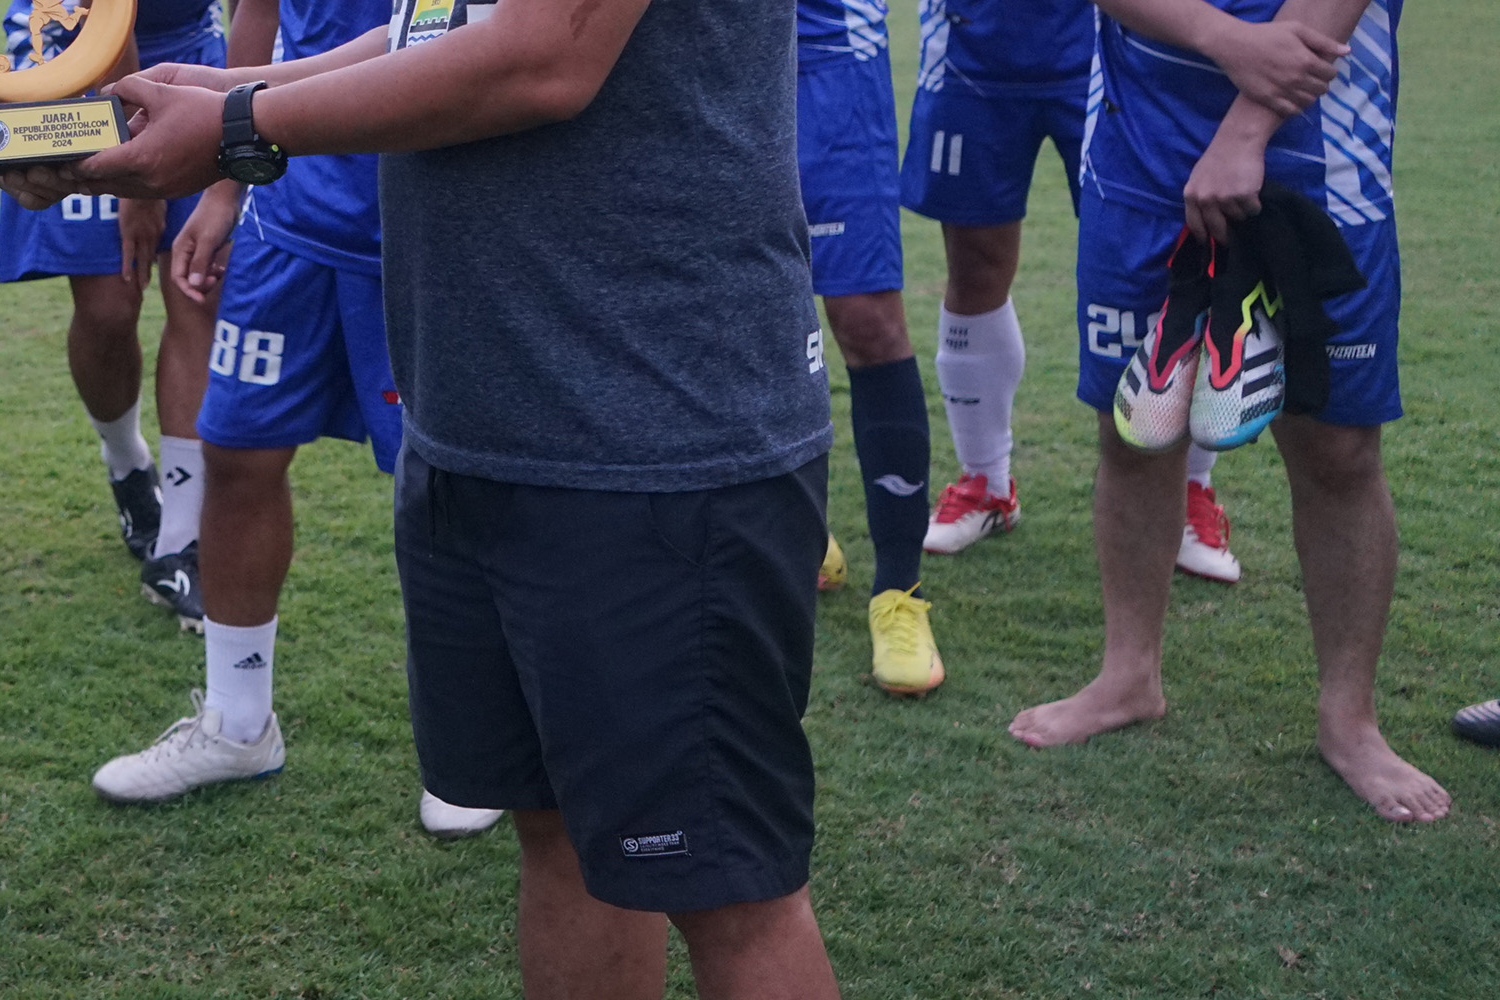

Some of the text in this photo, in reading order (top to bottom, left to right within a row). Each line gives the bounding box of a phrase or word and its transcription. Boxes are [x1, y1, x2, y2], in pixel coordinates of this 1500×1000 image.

[40, 112, 75, 124] JUARA
[13, 120, 109, 135] REPUBLIKBOBOTOH.COM
[22, 129, 101, 142] TROFEO RAMADHAN
[52, 139, 73, 148] 2024
[930, 130, 963, 176] 11
[209, 319, 285, 386] 88
